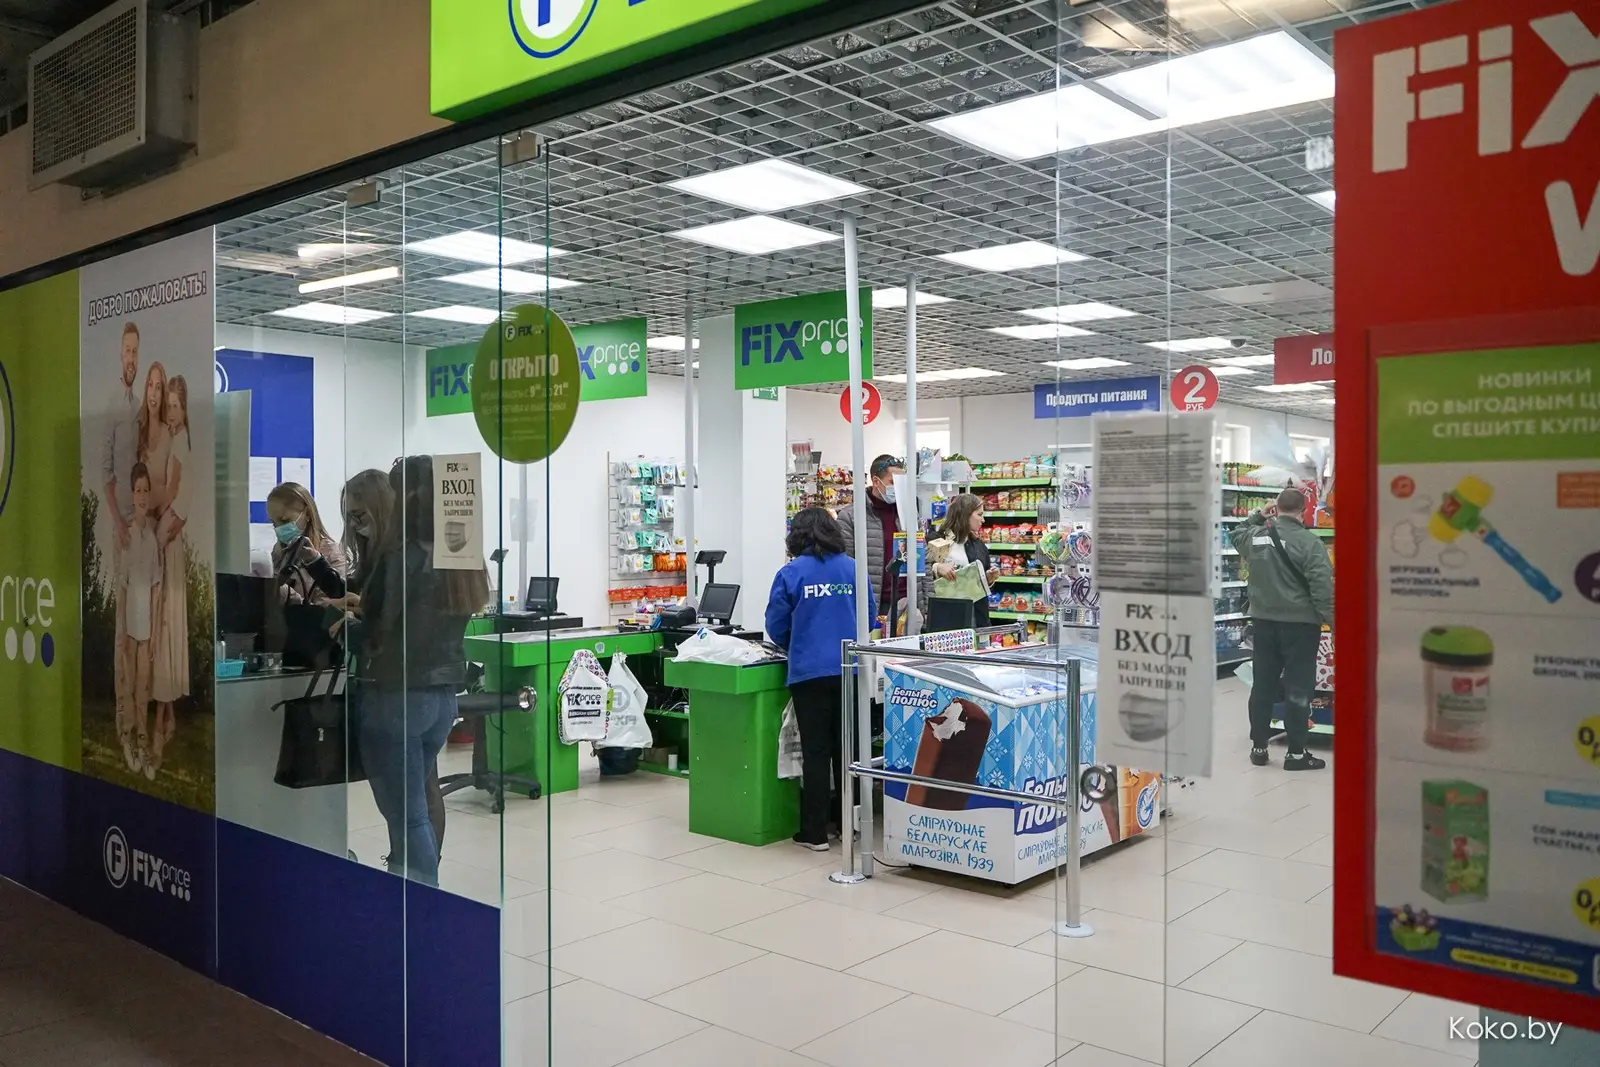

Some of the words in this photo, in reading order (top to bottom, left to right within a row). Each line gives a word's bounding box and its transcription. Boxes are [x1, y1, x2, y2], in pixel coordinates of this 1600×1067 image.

[88, 293, 123, 326] ДОБРО
[124, 270, 207, 314] ПОЖАЛОВАТЬ!
[1310, 347, 1335, 366] Ло
[1183, 371, 1206, 403] 2
[1477, 367, 1592, 389] НОВИНКИ
[1046, 391, 1098, 407] Продукты
[1100, 388, 1148, 403] питания
[1185, 403, 1204, 411] РУБ
[1407, 399, 1439, 416] ПО
[1443, 392, 1575, 415] ВЫГОДНЫМ
[1580, 391, 1600, 410] Ц
[1432, 419, 1536, 438] СПЕШИТЕ
[441, 479, 476, 497] ВХОД
[455, 499, 474, 507] МАСКИ
[1114, 628, 1193, 663] ВХОД
[1117, 659, 1138, 671] БЕЗ
[1142, 662, 1187, 676] МАСКИ
[967, 853, 994, 872] 1939
